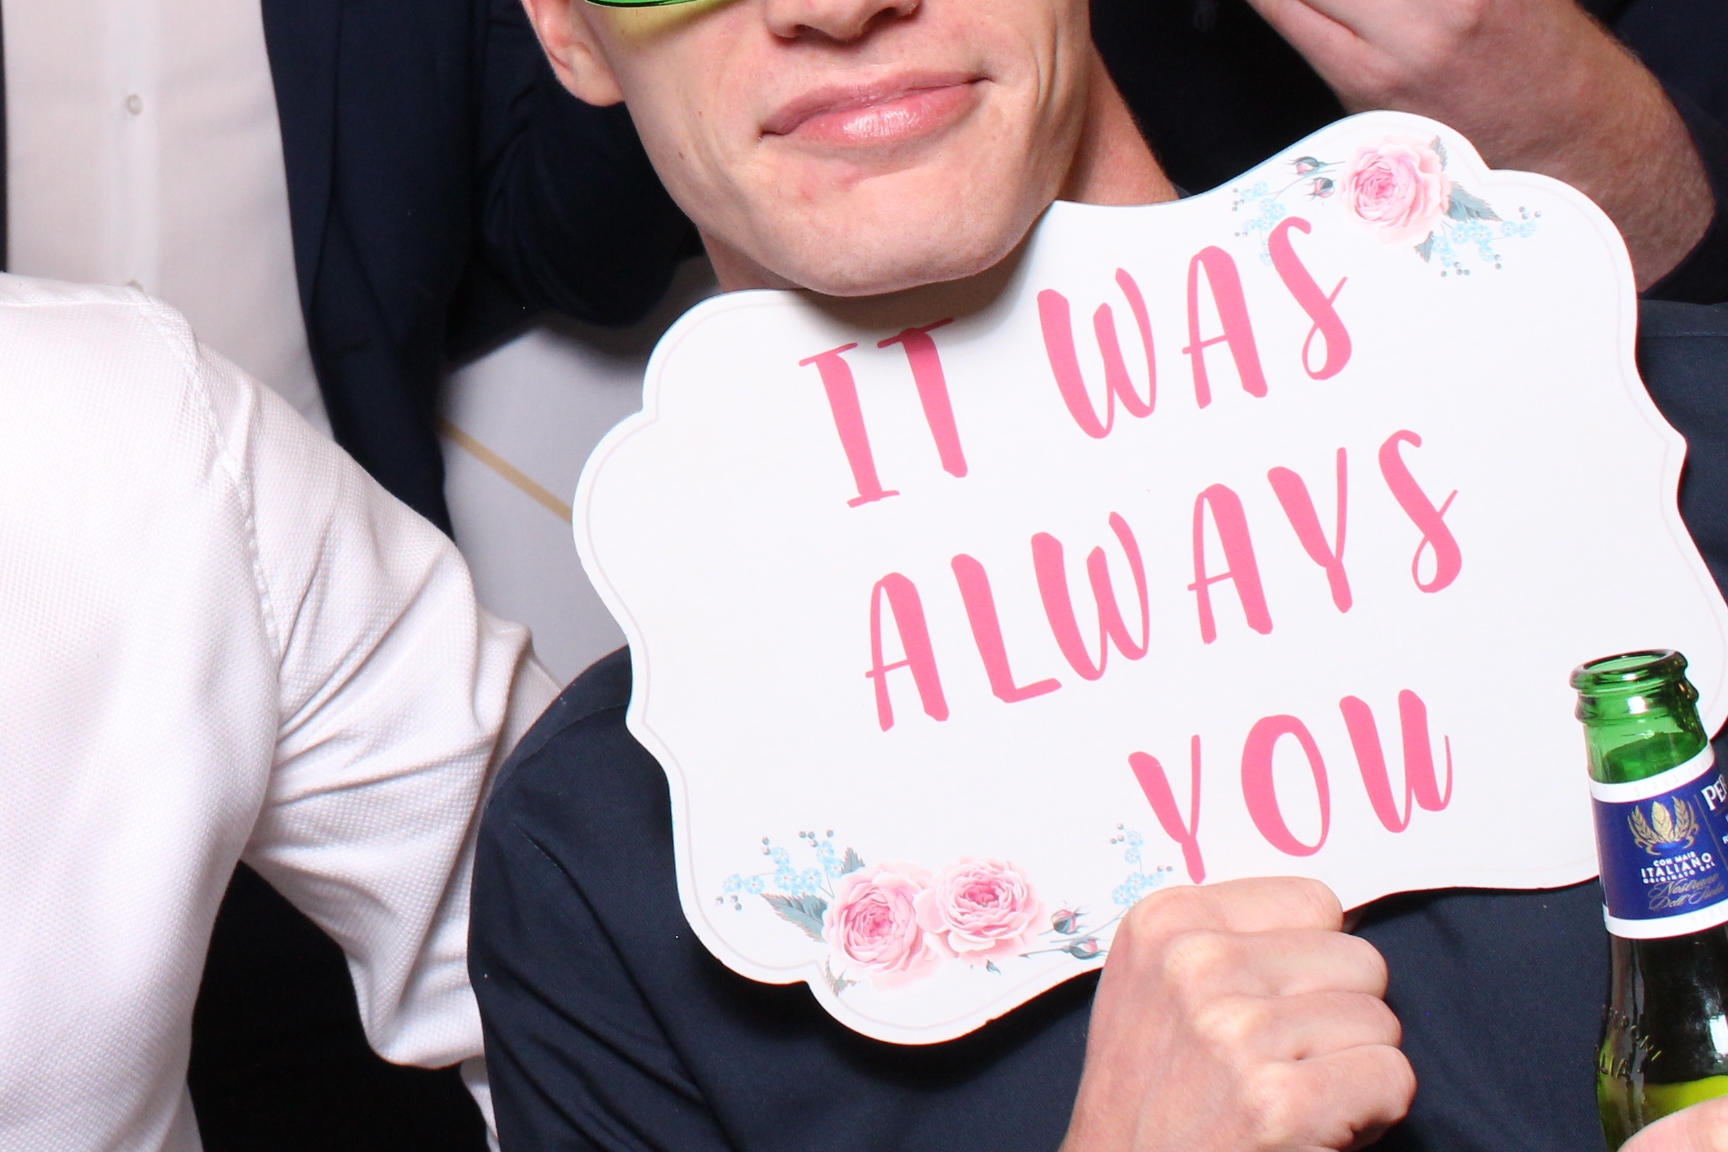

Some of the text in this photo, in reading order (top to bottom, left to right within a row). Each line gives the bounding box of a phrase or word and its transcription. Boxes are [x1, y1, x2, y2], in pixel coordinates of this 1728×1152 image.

[799, 216, 1353, 508] IT WAS
[865, 429, 1463, 732] ALWAYS
[1128, 689, 1453, 884] YOU
[1641, 852, 1712, 878] ITALIANO
